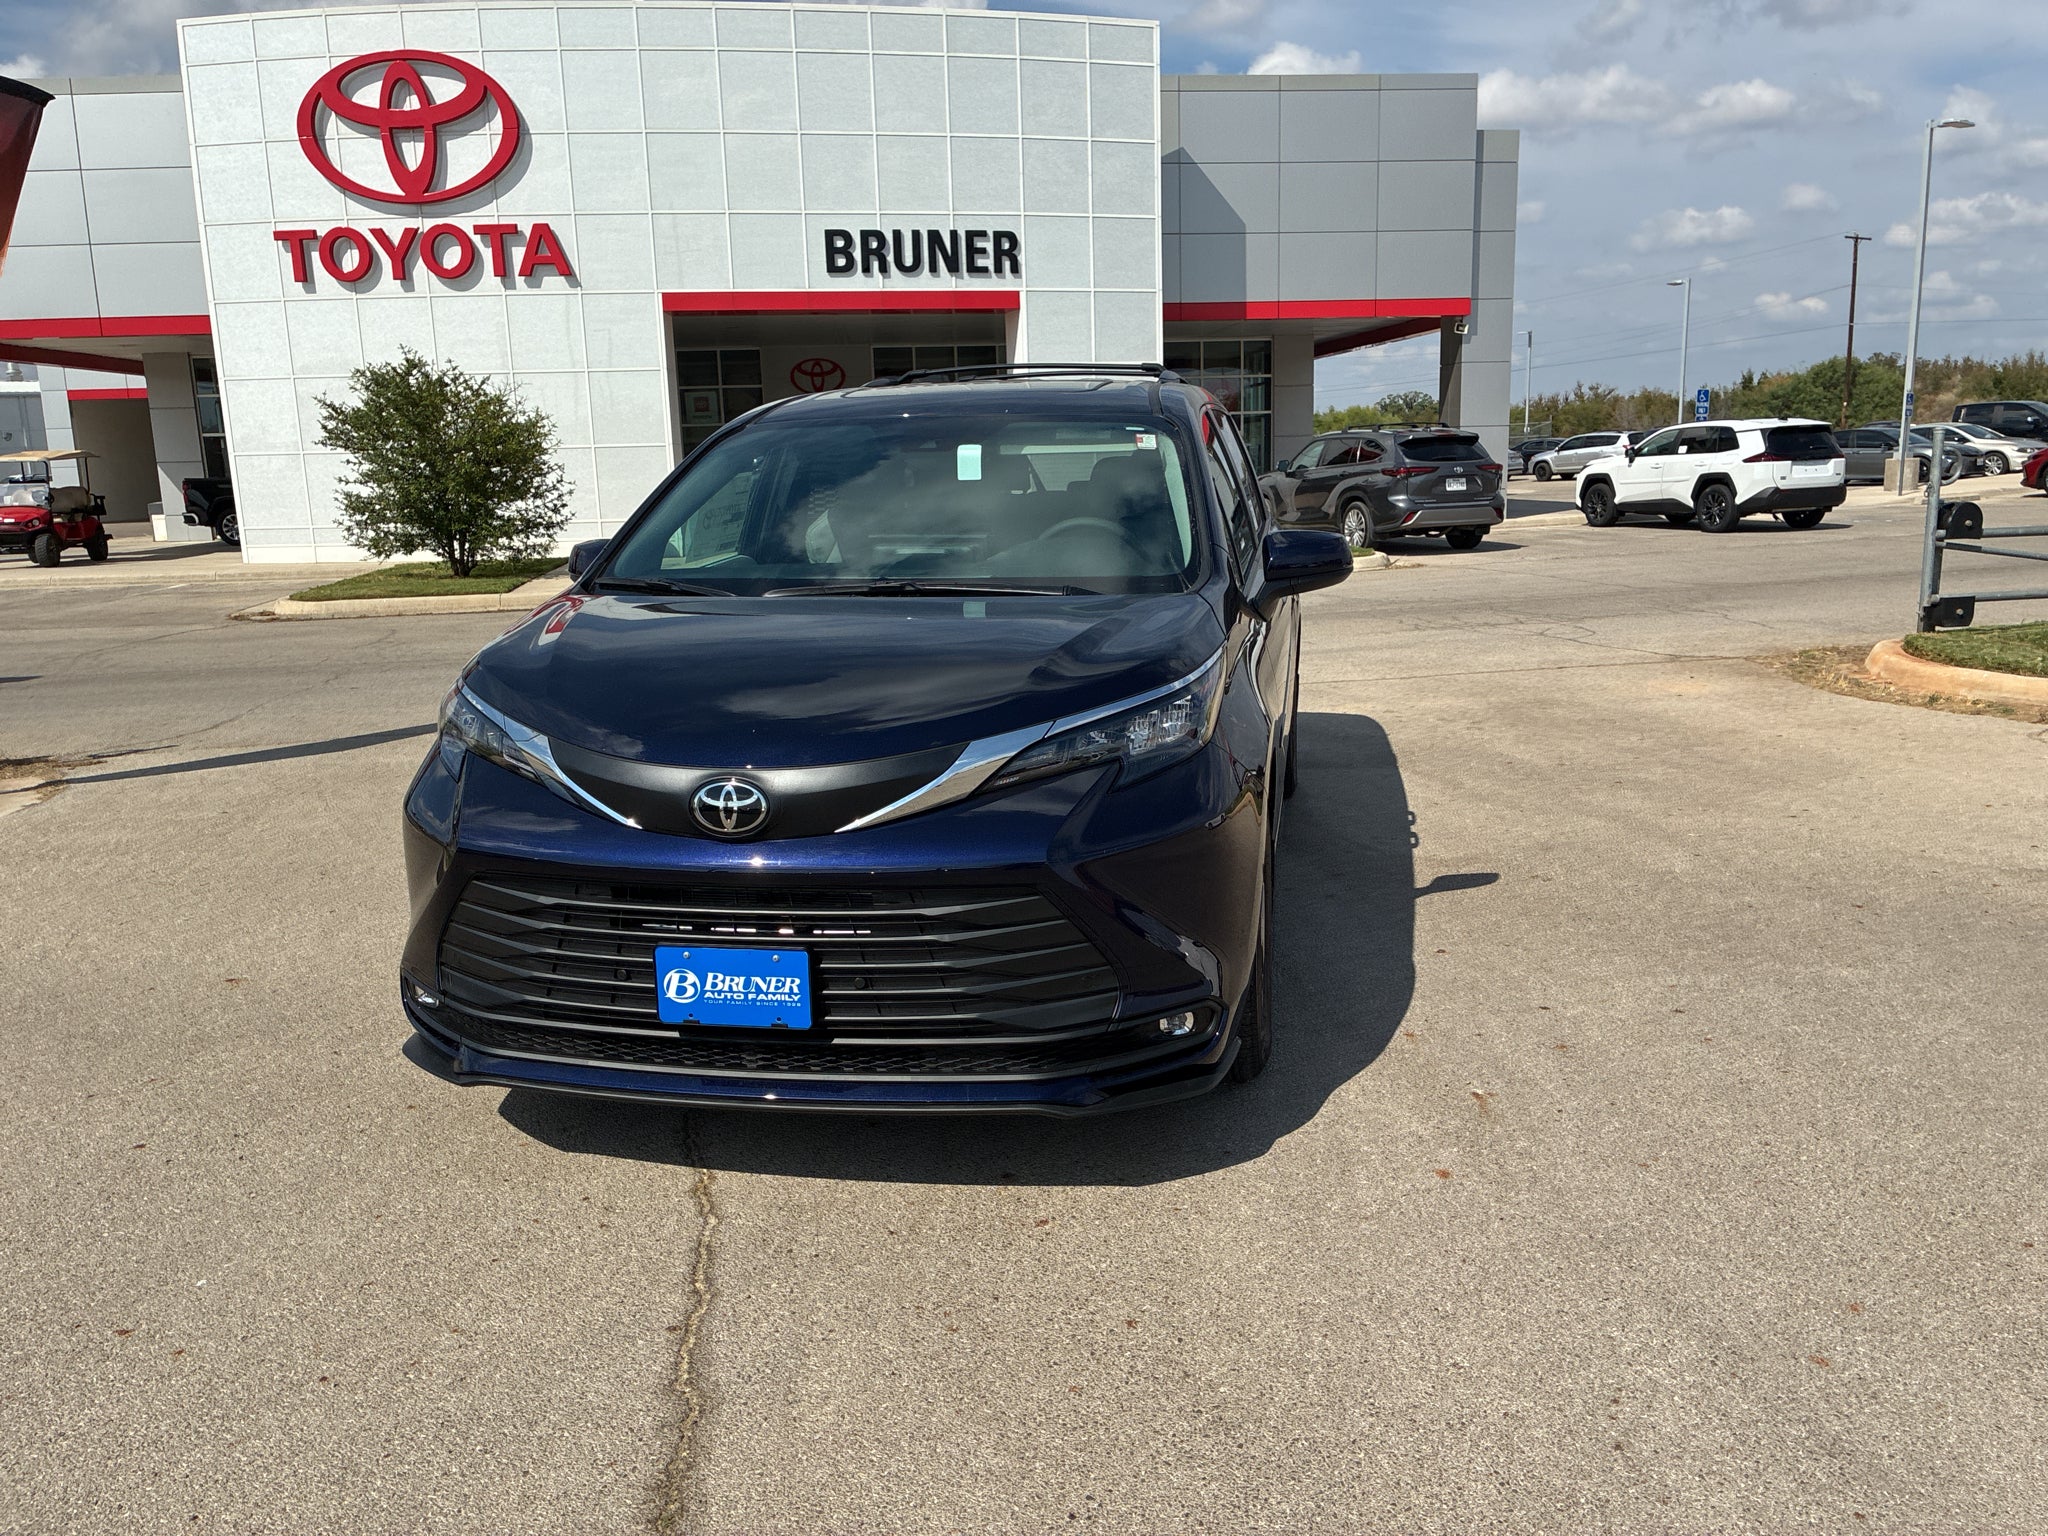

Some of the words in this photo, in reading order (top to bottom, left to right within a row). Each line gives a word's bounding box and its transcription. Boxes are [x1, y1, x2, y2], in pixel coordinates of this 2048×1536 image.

[273, 223, 573, 283] TOYOTA
[824, 229, 1019, 274] BRUNER
[703, 972, 801, 994] BRUNER
[703, 992, 744, 1000] AUTO
[748, 994, 801, 1002] FAMILY
